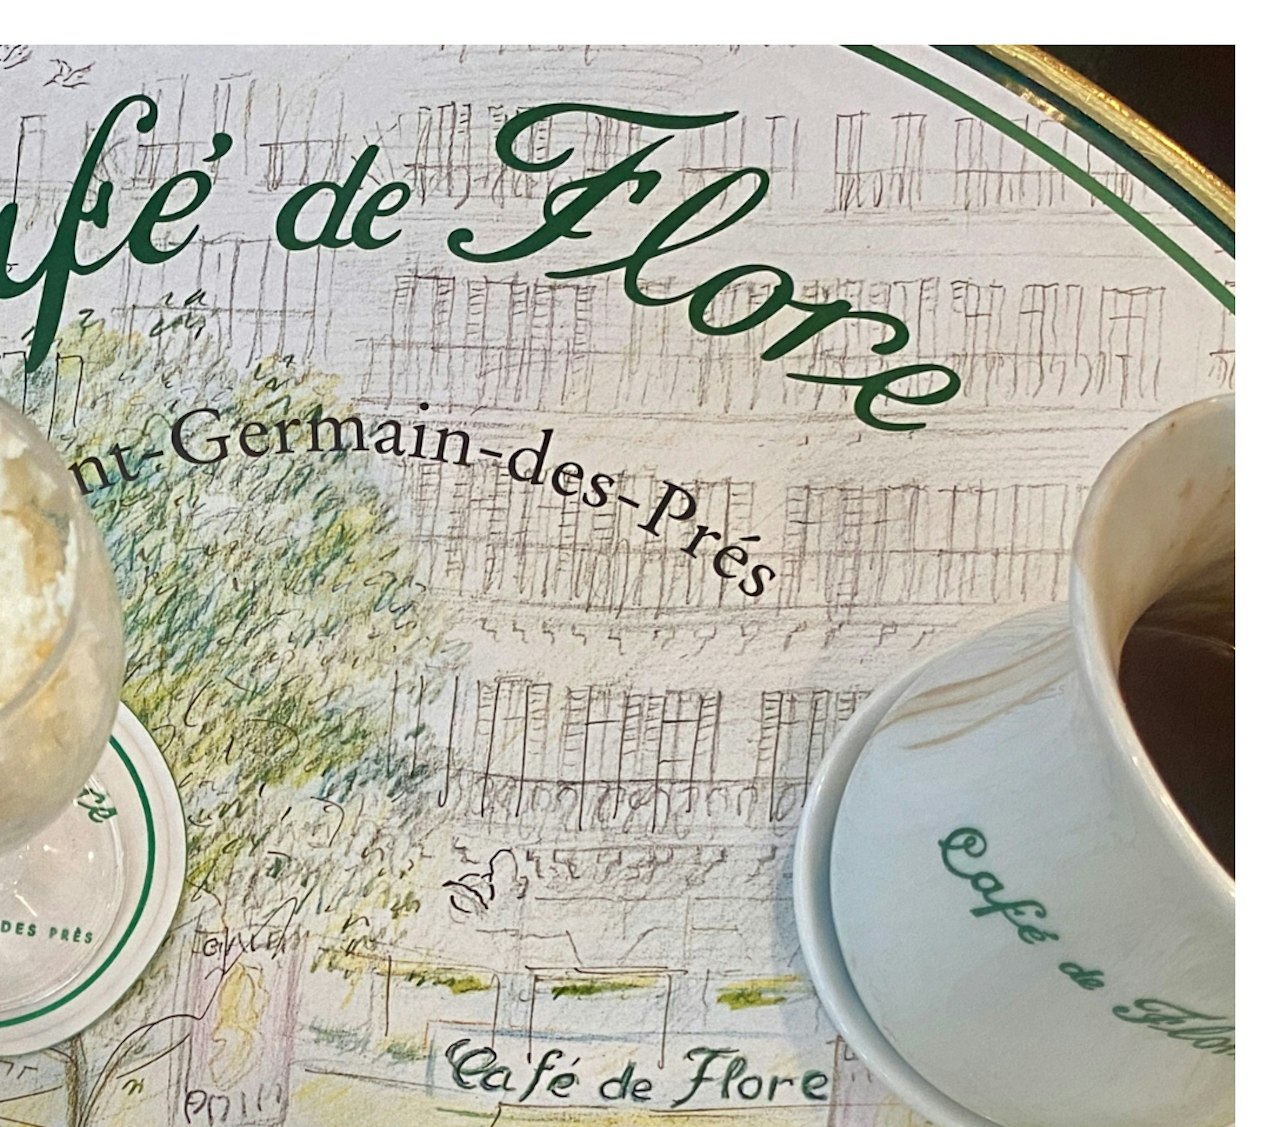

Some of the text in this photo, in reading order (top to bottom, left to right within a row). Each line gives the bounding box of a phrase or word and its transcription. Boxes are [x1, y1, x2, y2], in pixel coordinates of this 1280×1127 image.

[274, 144, 413, 251] de
[447, 101, 960, 431] Flore
[68, 401, 777, 598] nt-Germain-des-Prés
[1, 919, 37, 937] DES
[937, 827, 1060, 945] Café
[1058, 961, 1105, 991] de
[445, 1038, 581, 1103] Café
[599, 1059, 654, 1102] de
[670, 1046, 829, 1109] Flore
